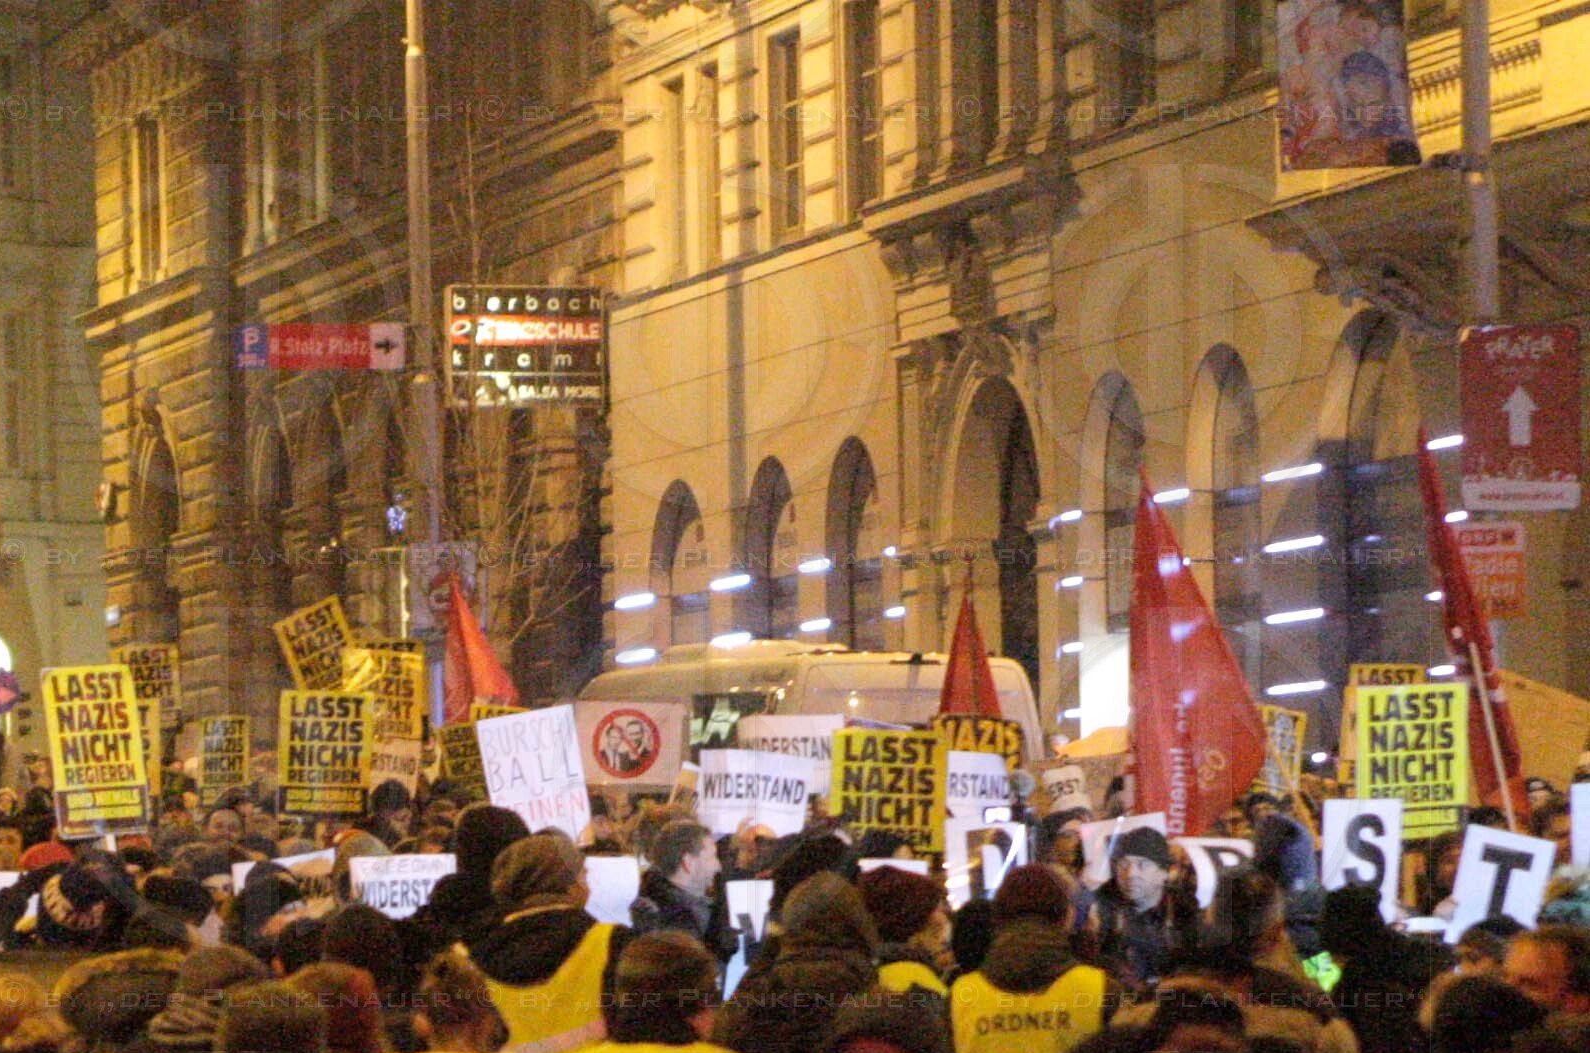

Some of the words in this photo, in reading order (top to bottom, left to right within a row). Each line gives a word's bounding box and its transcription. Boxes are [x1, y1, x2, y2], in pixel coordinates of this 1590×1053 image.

[282, 602, 334, 638] LASST
[51, 671, 124, 703] LASST
[56, 702, 130, 733] NAZIS
[290, 696, 365, 718] LASST
[1368, 691, 1455, 722] LASST
[289, 720, 364, 742] NAZIS
[1369, 722, 1455, 753] NAZIS
[60, 733, 132, 765] NICHT
[289, 745, 363, 767] NICHT
[843, 735, 937, 765] LASST
[65, 764, 137, 786] REGIEREN
[288, 768, 360, 784] REGIEREN
[487, 747, 579, 794] BALL
[842, 766, 936, 796] NAZIS
[1369, 754, 1455, 785] NICHT
[703, 773, 806, 805] WIDERSTAND
[842, 796, 934, 826] NICHT
[1343, 813, 1386, 887] S
[1482, 843, 1534, 918] T
[976, 1010, 1071, 1037] ORDNER
